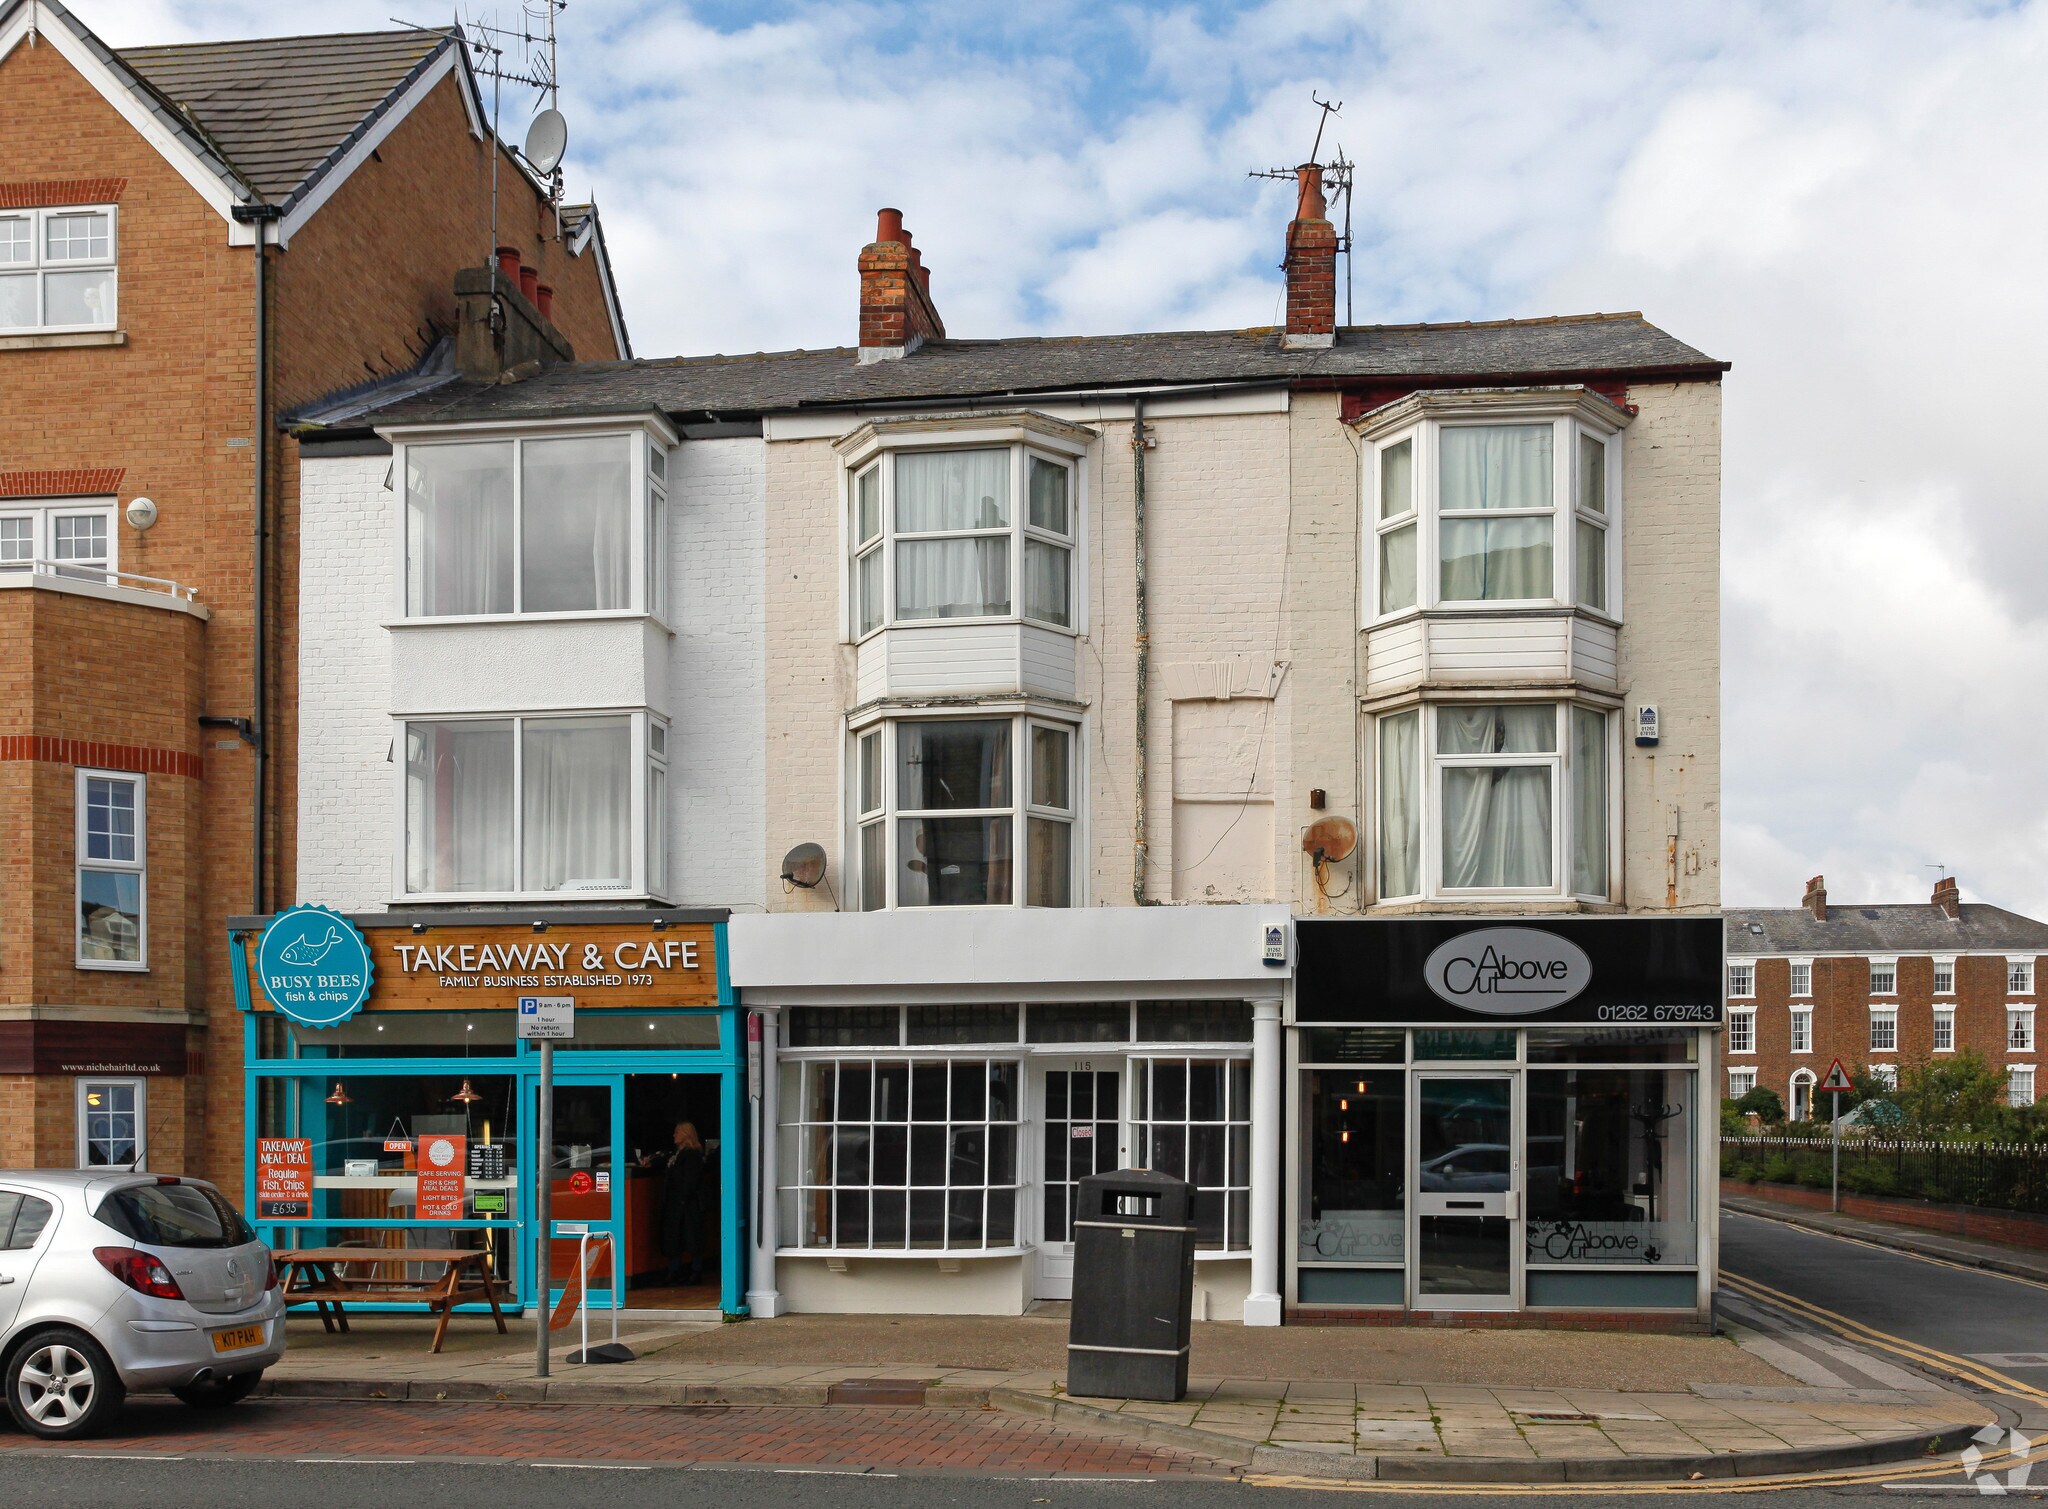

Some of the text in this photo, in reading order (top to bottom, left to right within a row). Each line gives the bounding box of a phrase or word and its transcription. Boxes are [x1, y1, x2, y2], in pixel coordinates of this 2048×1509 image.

[393, 941, 699, 972] TAKEAWAY & CAFE
[270, 974, 360, 988] BUSY BEES
[440, 974, 652, 987] FAMILY BUSINESS ESTABLISHED 1973
[286, 991, 348, 1002] fish & chips
[525, 1000, 535, 1013] P
[1598, 1005, 1714, 1020] 01262 679743
[62, 1063, 161, 1072] www.nichehairltd.co.uk
[1074, 1062, 1091, 1070] 115
[1072, 1126, 1092, 1137] Closed
[261, 1141, 305, 1152] TAKEAWAY
[261, 1153, 308, 1164] MEAL DEAL
[268, 1169, 299, 1180] Regular
[284, 1180, 304, 1191] Chips
[1571, 1224, 1638, 1249] Above
[222, 1329, 256, 1347] K17 PAH
